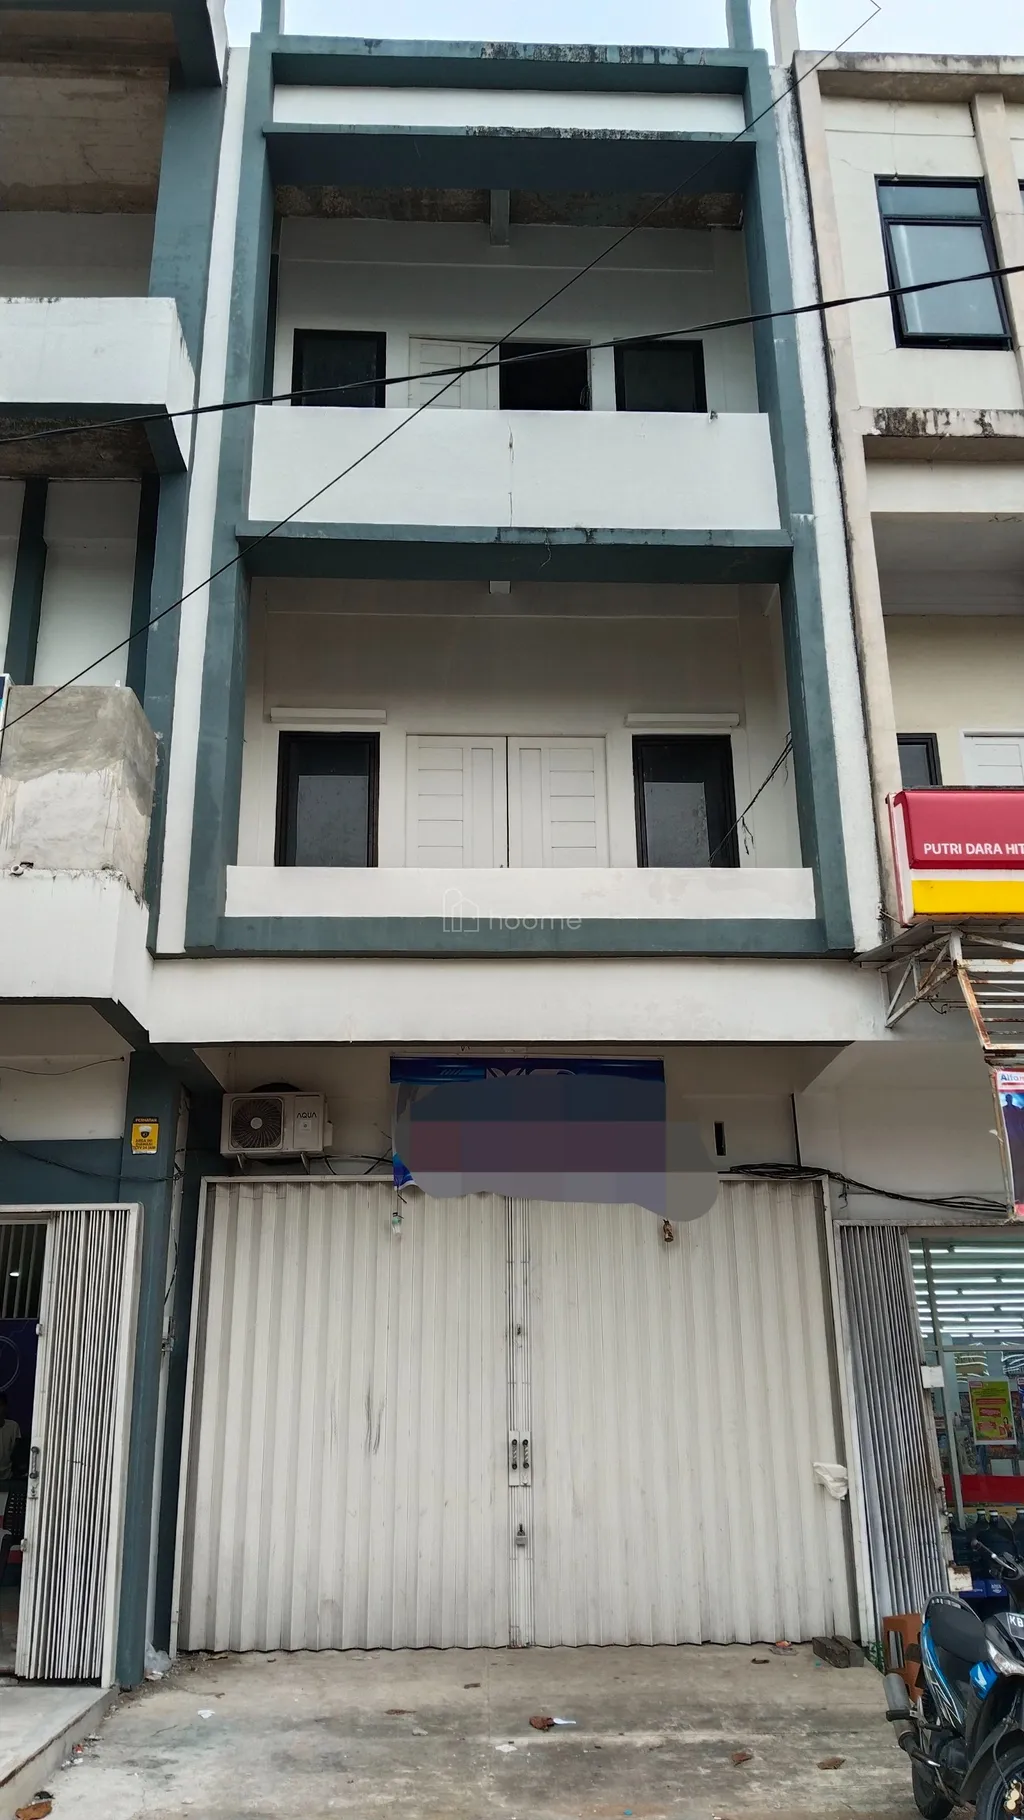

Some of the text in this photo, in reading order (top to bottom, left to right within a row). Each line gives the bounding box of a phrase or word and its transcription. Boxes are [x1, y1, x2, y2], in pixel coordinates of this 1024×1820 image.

[923, 843, 962, 855] PUTRI
[965, 843, 1003, 855] DARA
[296, 1111, 318, 1119] AQUA
